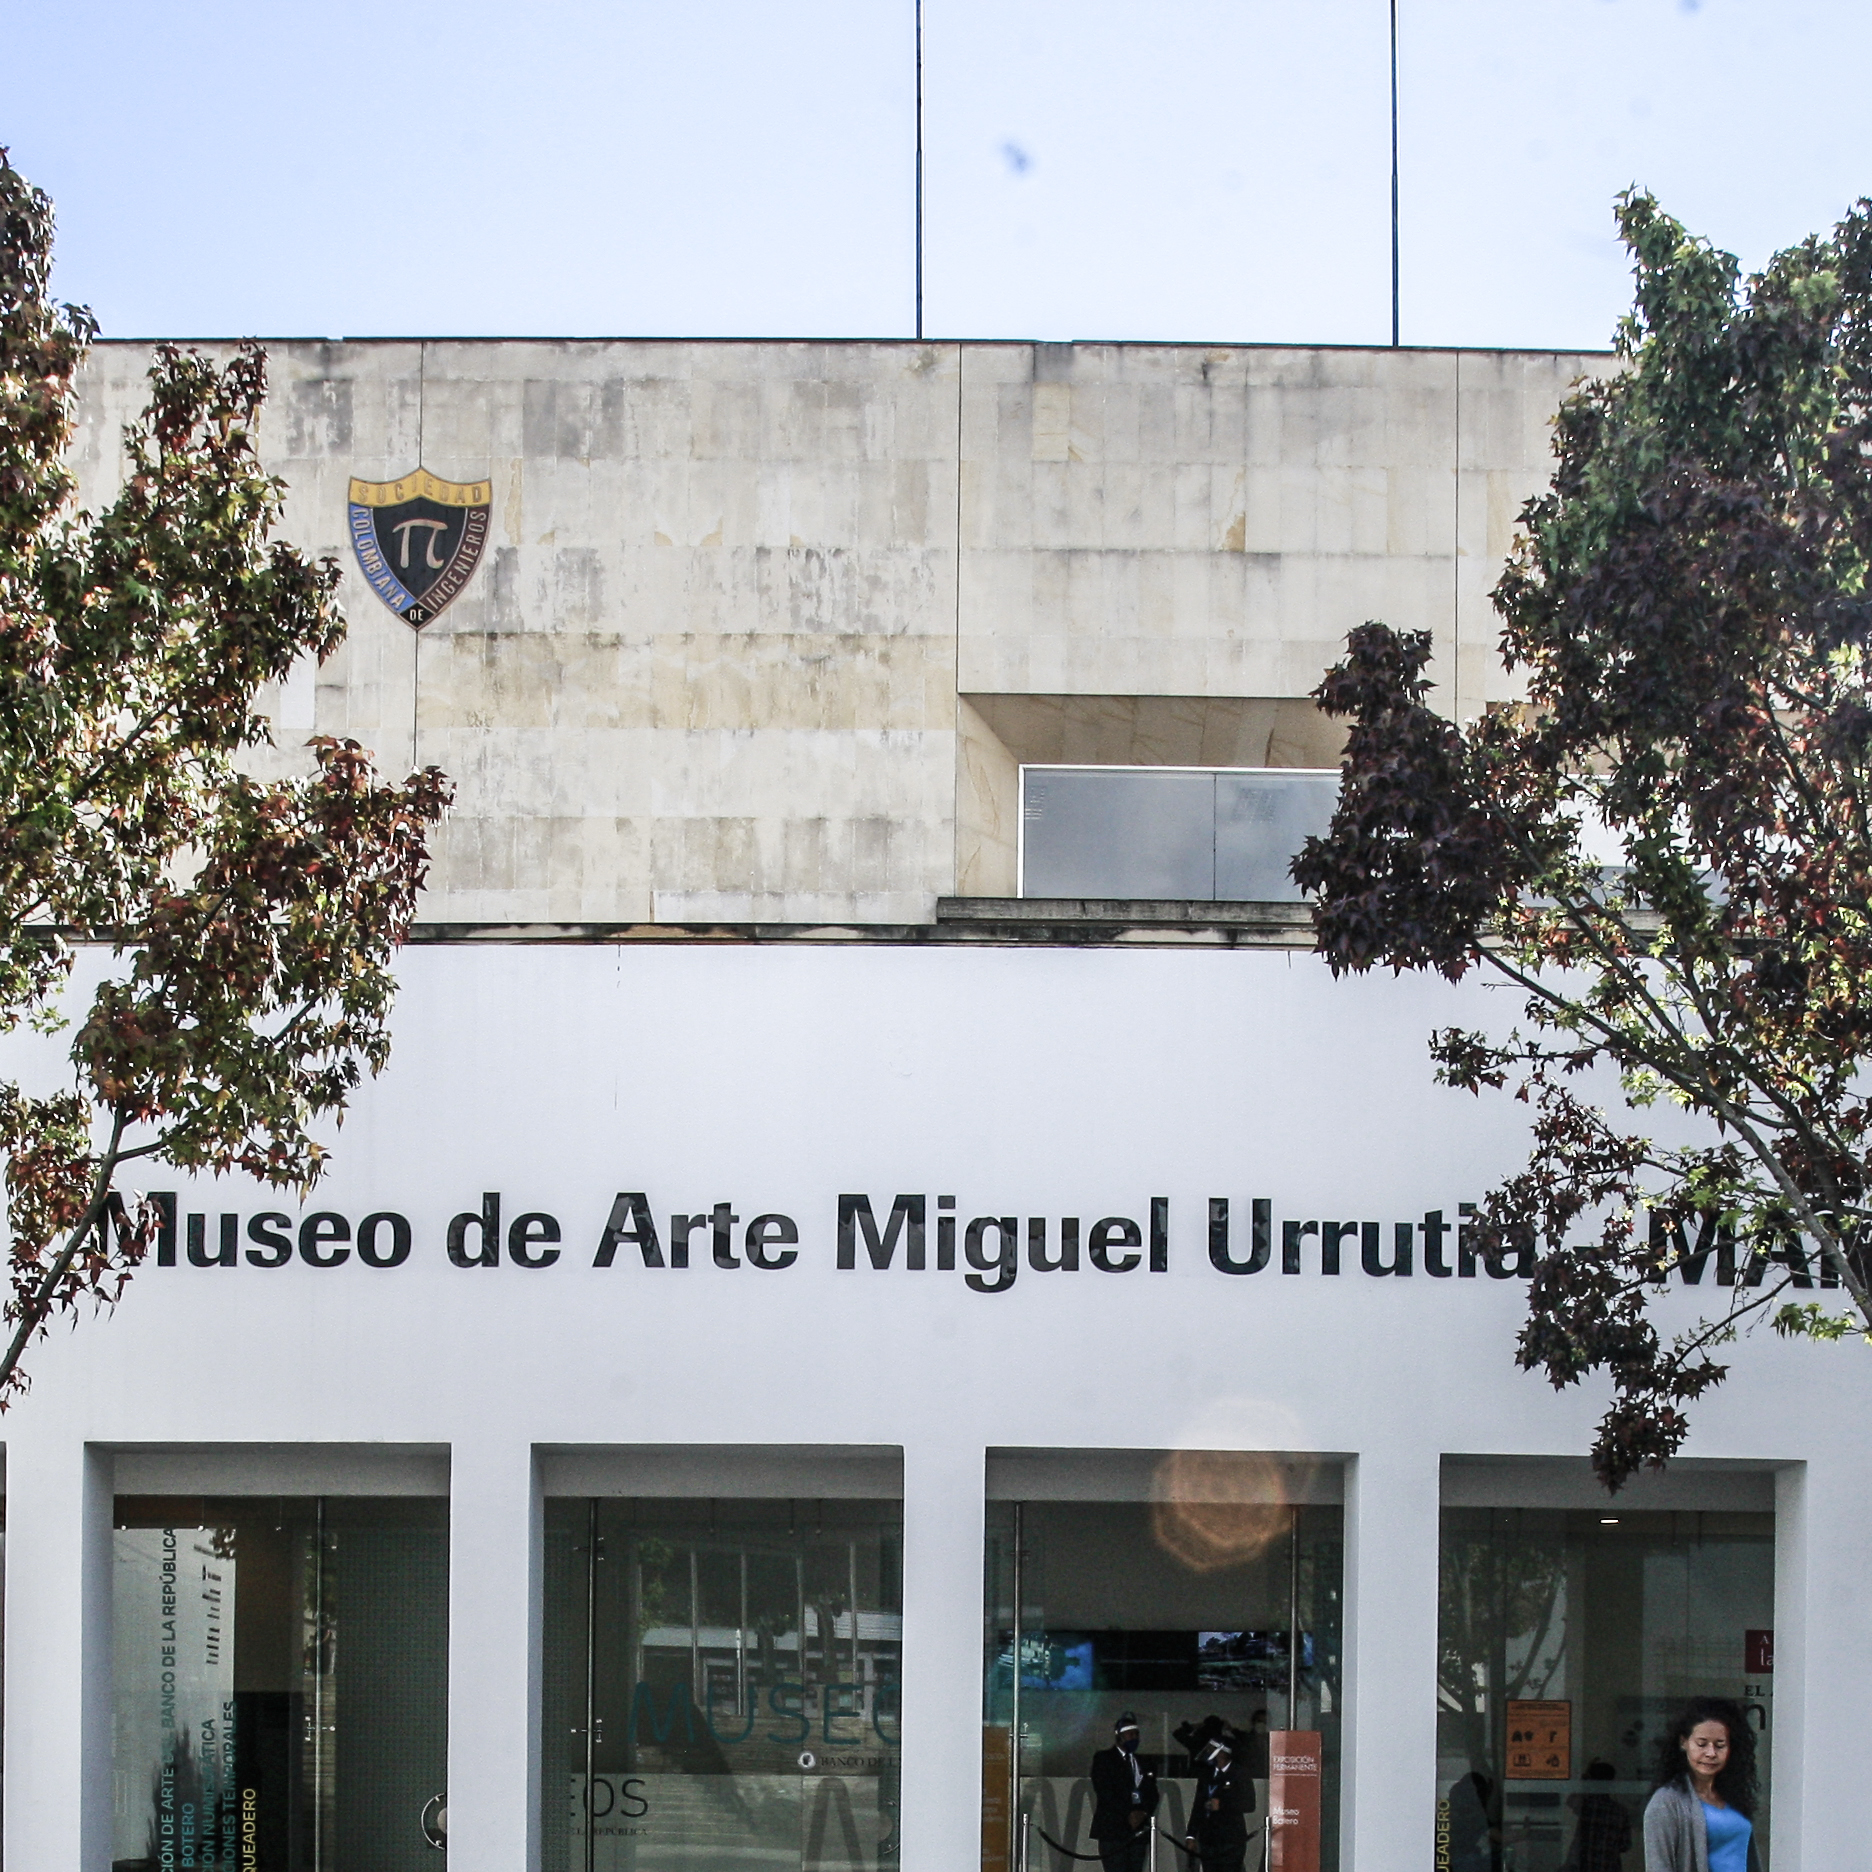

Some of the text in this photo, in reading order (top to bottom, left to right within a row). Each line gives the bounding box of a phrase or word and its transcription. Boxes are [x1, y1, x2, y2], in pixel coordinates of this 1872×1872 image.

[358, 475, 482, 504] SOCIEDAD
[352, 508, 407, 613] COLOMBIANA
[426, 511, 487, 610] INGENIEROS
[409, 609, 424, 622] DE
[89, 1191, 412, 1269] Museo
[447, 1192, 562, 1269] de
[592, 1192, 799, 1270] Arte
[836, 1193, 1169, 1293] Miguel
[1207, 1196, 1536, 1279] Urrutia
[159, 1528, 177, 1617] REPÚBLICA
[161, 1619, 176, 1642] LA
[161, 1645, 175, 1667] DE
[161, 1671, 175, 1729] BANCO
[222, 1700, 237, 1811] TEMPORALES
[820, 1756, 865, 1766] BANCO
[1273, 1763, 1318, 1771] PERMANENTE
[161, 1767, 174, 1810] ARTE
[161, 1813, 174, 1835] DE
[181, 1802, 195, 1867] BOTERO
[1272, 1815, 1299, 1825] Botero
